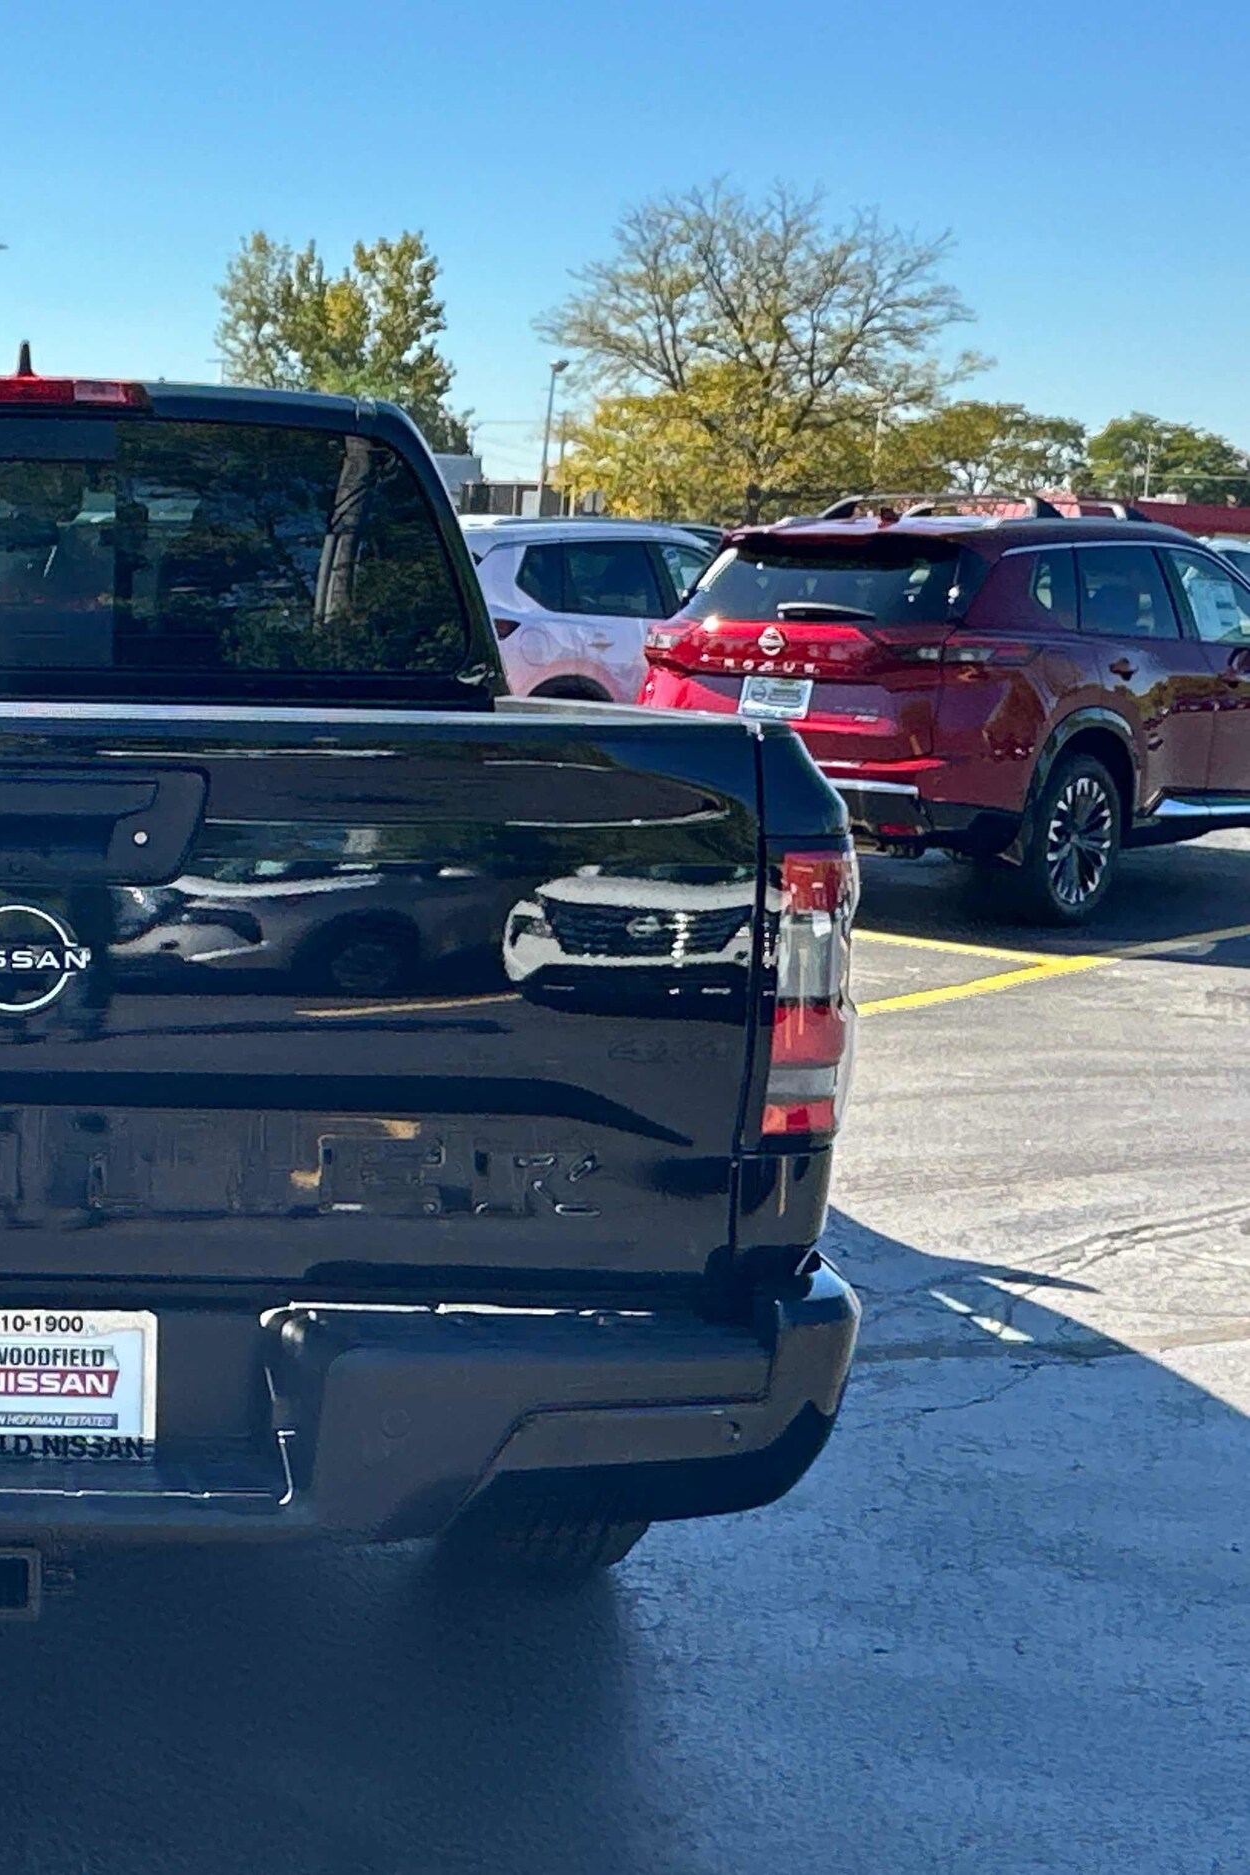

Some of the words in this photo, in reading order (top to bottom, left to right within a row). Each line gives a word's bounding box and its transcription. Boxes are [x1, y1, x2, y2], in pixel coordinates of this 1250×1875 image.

[8, 1415, 62, 1426] HOFFMAN
[63, 1416, 113, 1427] ESTATES
[41, 1434, 144, 1459] NISSAN
